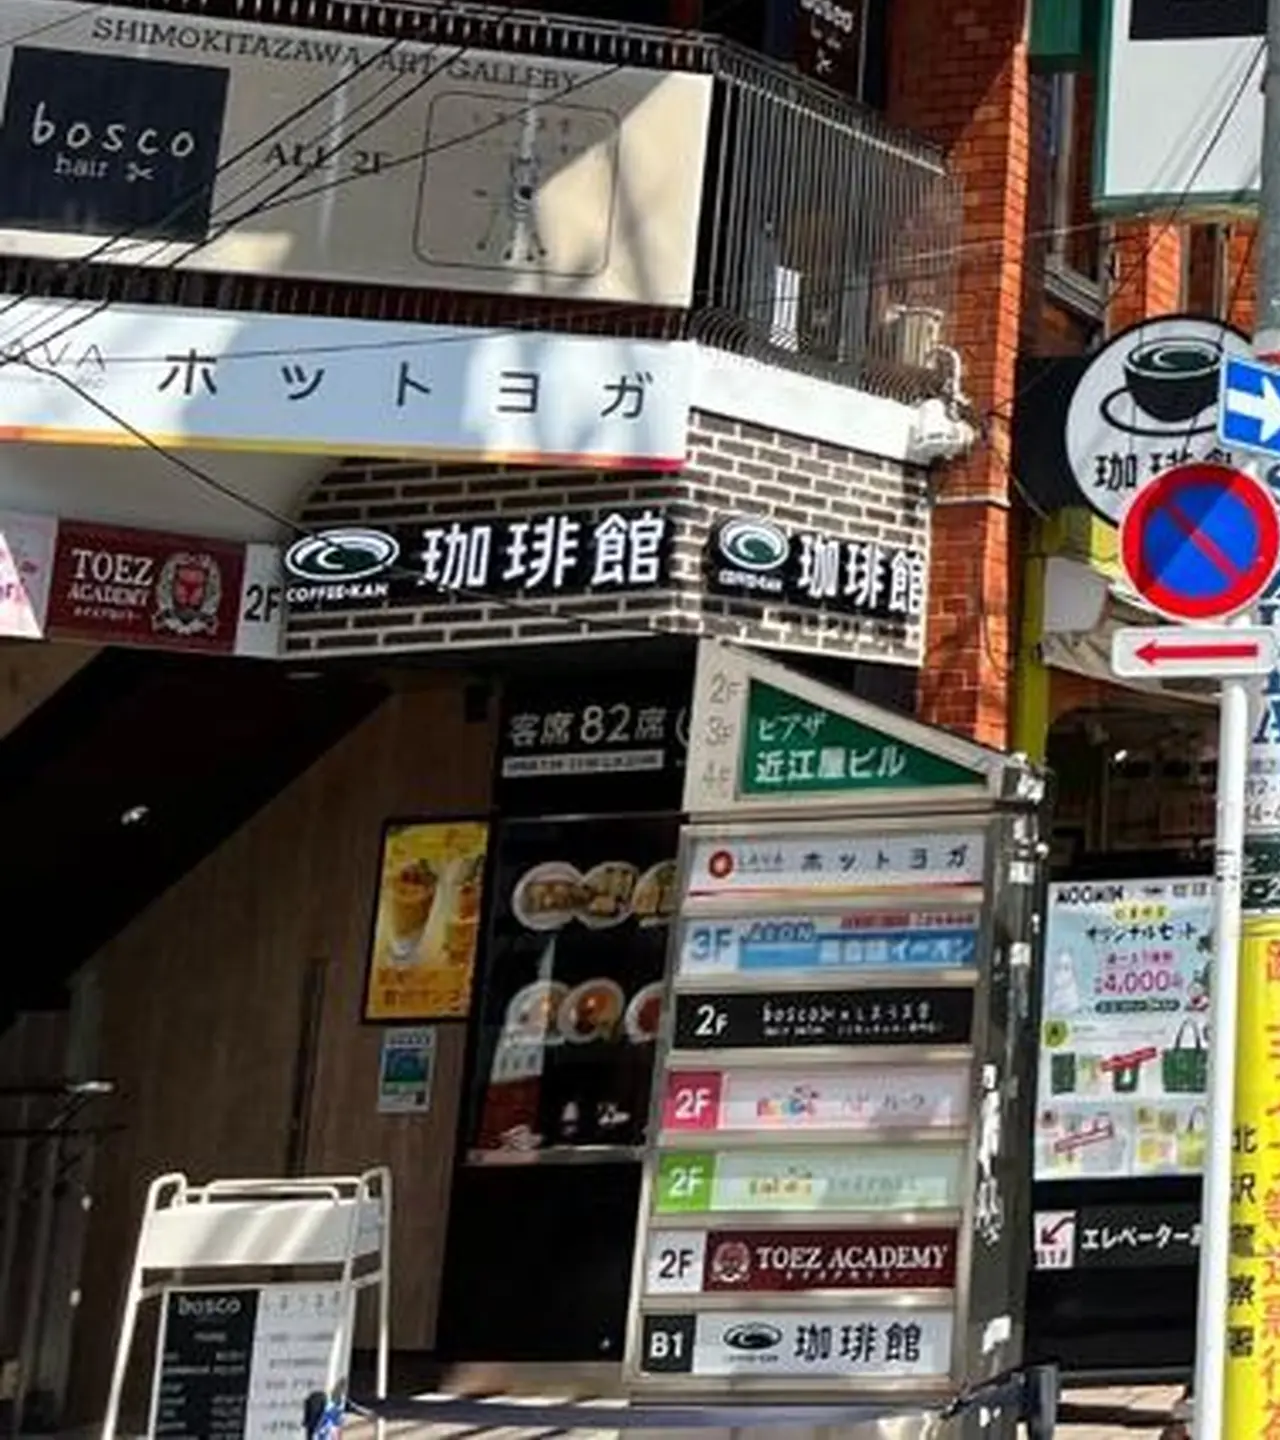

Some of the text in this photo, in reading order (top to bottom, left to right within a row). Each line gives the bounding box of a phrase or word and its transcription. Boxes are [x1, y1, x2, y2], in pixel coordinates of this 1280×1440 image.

[92, 16, 580, 93] SHIMOKITAZAWA ART GALLERY
[31, 101, 196, 160] bosco
[53, 151, 110, 181] hair
[262, 141, 334, 172] ALL
[157, 345, 653, 420] ホットヨガ
[71, 548, 154, 587] TOEZ
[418, 512, 665, 593] 珈琲館
[797, 534, 924, 614] 珈琲館
[67, 581, 150, 608] ACADEMY
[244, 583, 282, 624] 2F
[709, 672, 741, 706] 2F
[704, 716, 734, 747] 3F
[756, 745, 907, 785] 近江屋ビル
[801, 844, 969, 872] ホットヨガ
[690, 929, 732, 958] 3F
[695, 1003, 729, 1036] 2F
[674, 1088, 711, 1120] 2F
[668, 1167, 705, 1198] 2F
[658, 1249, 694, 1280] 2F
[755, 1244, 949, 1271] TOEZ ACADEMY
[650, 1332, 685, 1357] B1
[794, 1321, 924, 1363] 珈琲館
